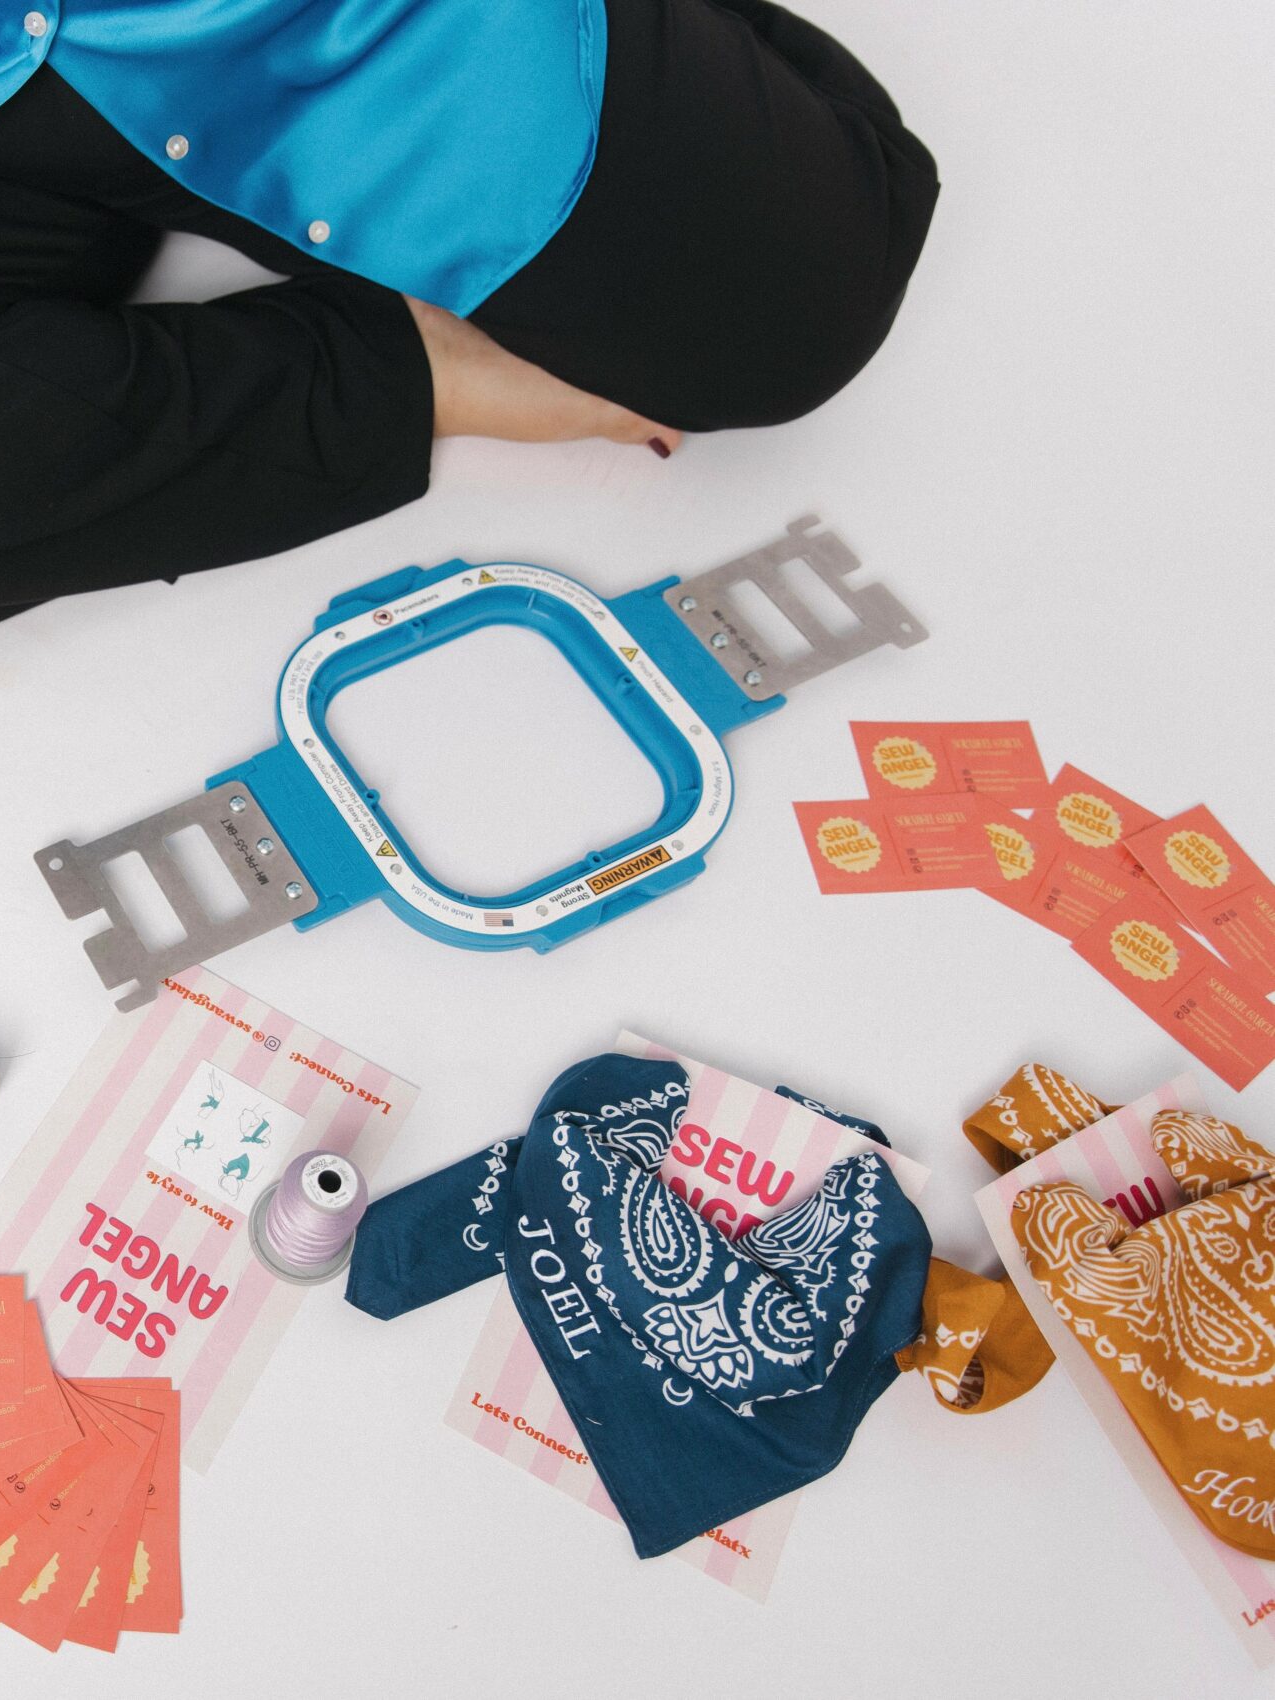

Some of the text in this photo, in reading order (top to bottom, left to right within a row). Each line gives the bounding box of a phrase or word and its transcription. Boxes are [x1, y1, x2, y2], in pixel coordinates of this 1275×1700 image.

[652, 677, 674, 704] Hazard
[878, 744, 915, 761] SEW
[881, 756, 932, 776] ANGEL
[308, 752, 375, 843] Keep Away From Computer
[329, 764, 383, 839] Disks and Hard Drives
[1070, 797, 1110, 821] SEW
[822, 824, 859, 842] SEW
[1060, 806, 1116, 838] ANGEL
[220, 818, 270, 886] MH-PR-55-BKT
[826, 838, 877, 859] ANGEL
[996, 849, 1027, 869] GEL
[1169, 839, 1220, 884] ANGEL
[1185, 834, 1224, 866] SEW
[592, 856, 655, 890] WARNING
[411, 883, 427, 899] USA
[427, 895, 441, 908] the
[548, 883, 584, 904] Magnets
[560, 890, 591, 909] Strong
[451, 905, 474, 921] Made
[1114, 933, 1170, 975] ANGEL
[1128, 923, 1171, 955] SEW
[159, 977, 266, 1043] @ sewangelatx
[289, 1050, 393, 1116] Lets Connect:
[671, 1122, 795, 1208] SEW
[145, 1169, 235, 1232] How to style
[78, 1201, 230, 1321] ANGEL
[517, 1213, 603, 1361] JOEL
[60, 1267, 177, 1359] SEW
[470, 1391, 590, 1467] Lets Connect:
